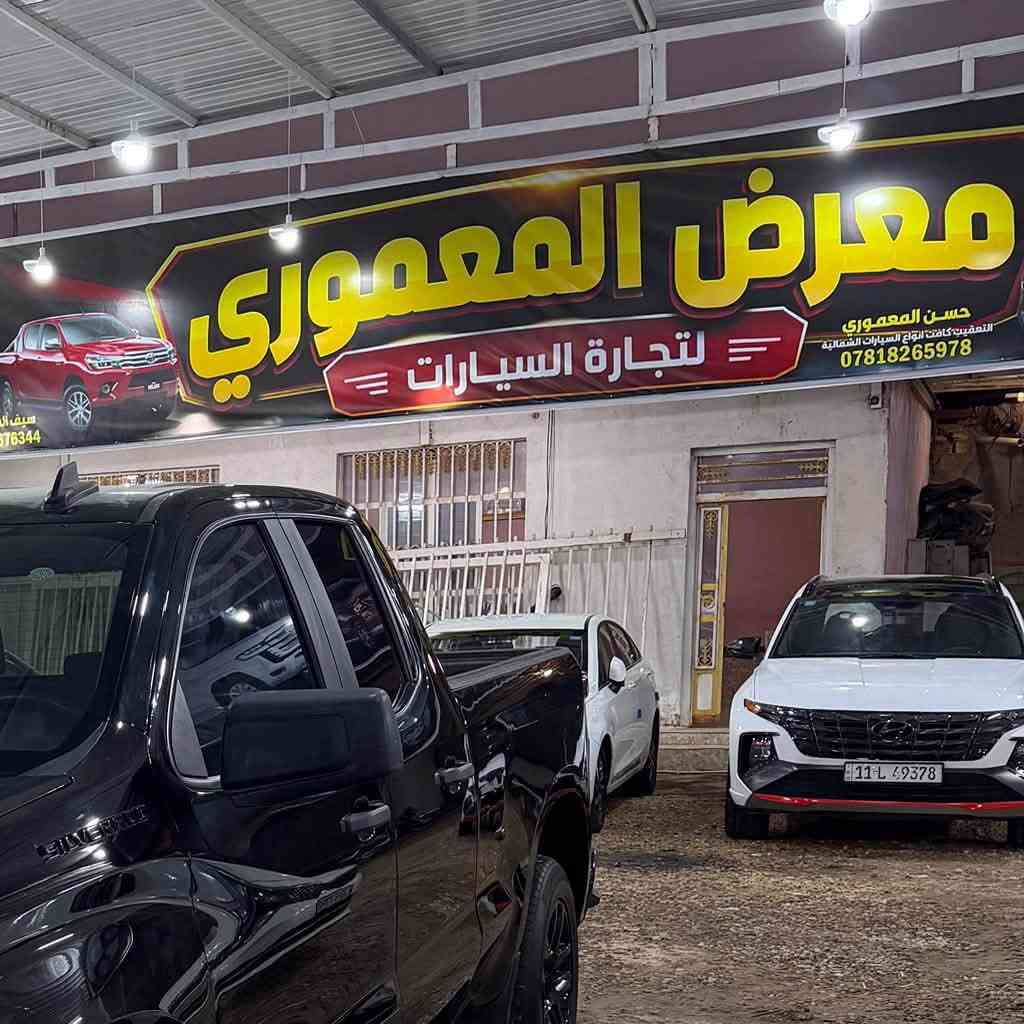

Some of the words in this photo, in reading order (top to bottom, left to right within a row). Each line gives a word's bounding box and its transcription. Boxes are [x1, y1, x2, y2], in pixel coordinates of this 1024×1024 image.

[674, 167, 1016, 309] معرض
[189, 180, 643, 403] المعموري
[841, 309, 921, 337] المعموري
[924, 306, 971, 325] حسن
[821, 337, 861, 351] الشمالية
[840, 338, 972, 369] 07818265978
[862, 333, 901, 347] السيارات
[407, 340, 573, 397] السيارات
[584, 329, 706, 382] لتجارة
[9, 414, 36, 429] سيف
